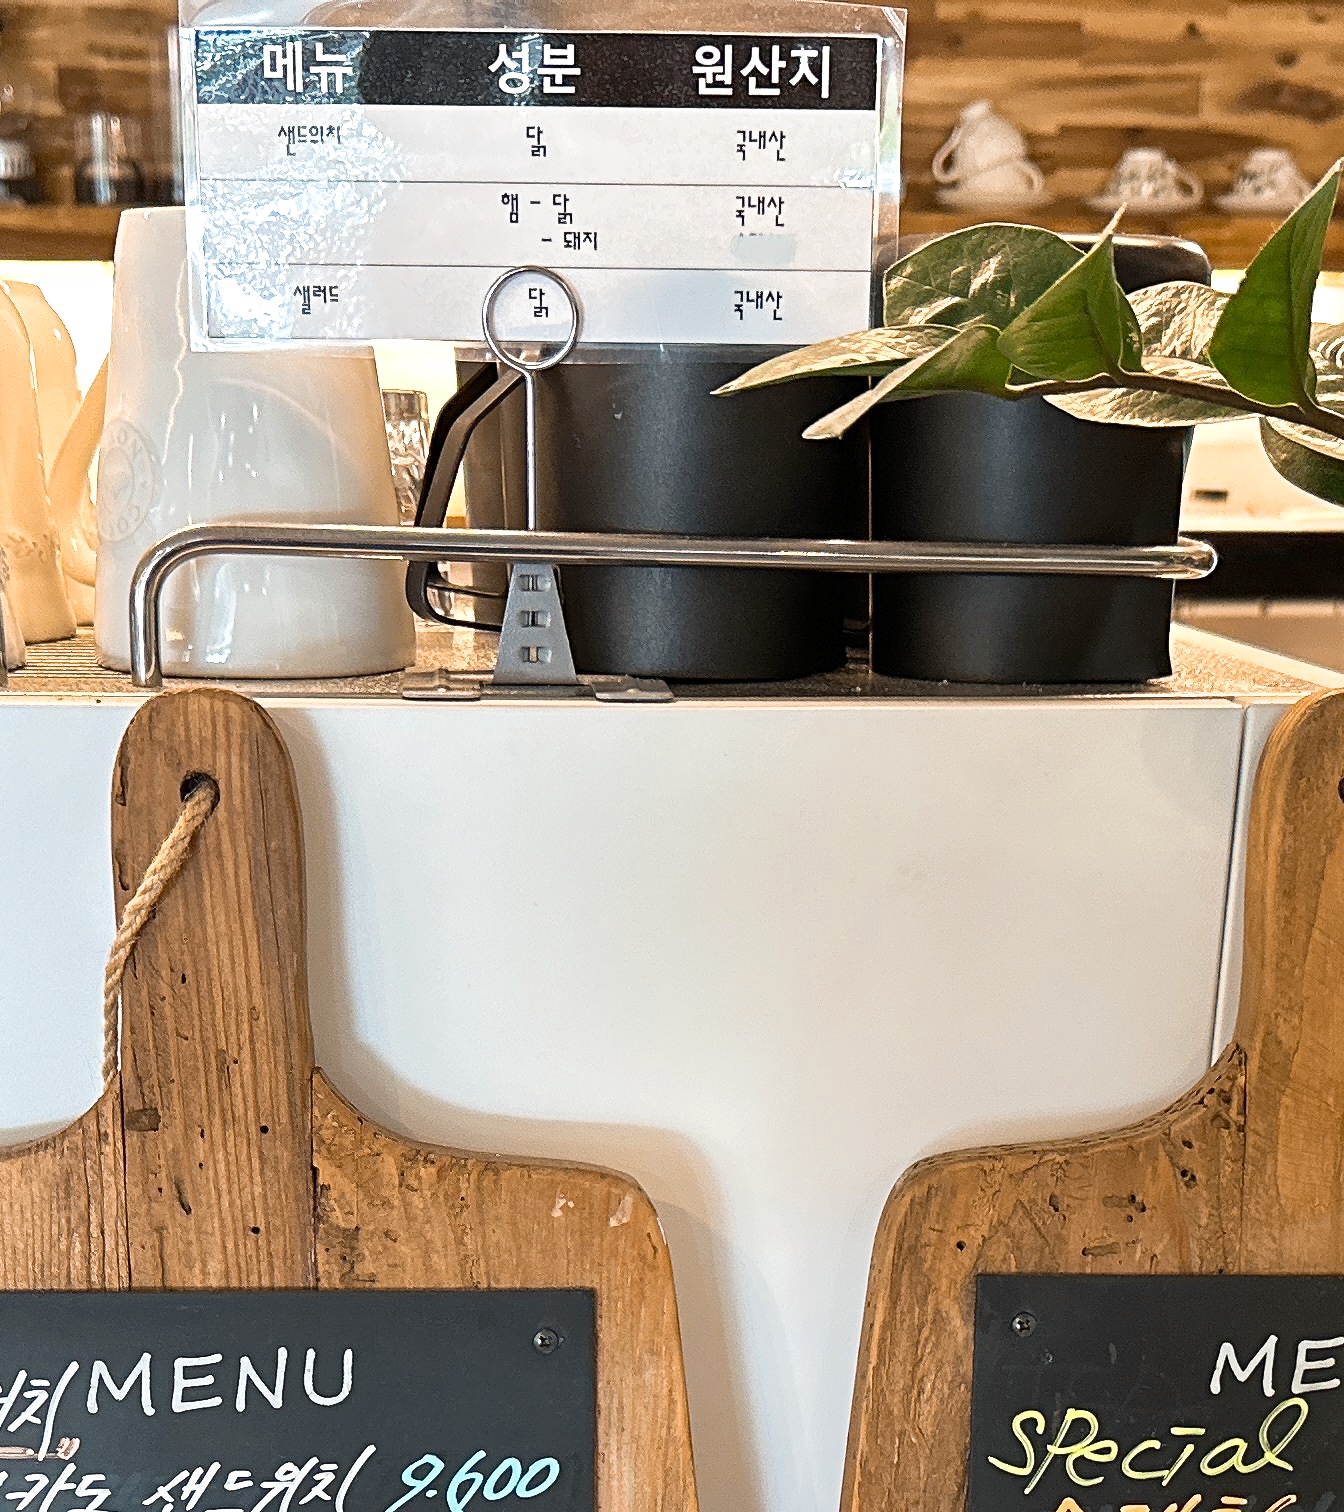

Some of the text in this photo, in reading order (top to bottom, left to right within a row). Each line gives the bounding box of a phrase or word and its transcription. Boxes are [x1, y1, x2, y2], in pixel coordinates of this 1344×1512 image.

[261, 43, 833, 100] 메뉴 성분 원산지
[525, 125, 549, 159] 닭
[734, 128, 788, 163] 국내산
[500, 193, 521, 225] 햄
[551, 193, 575, 227] 닭
[734, 195, 786, 228] 국내산
[561, 229, 600, 252] 돼지
[292, 285, 784, 322] 샐러드 닭 국내산
[87, 1347, 352, 1416] MENU
